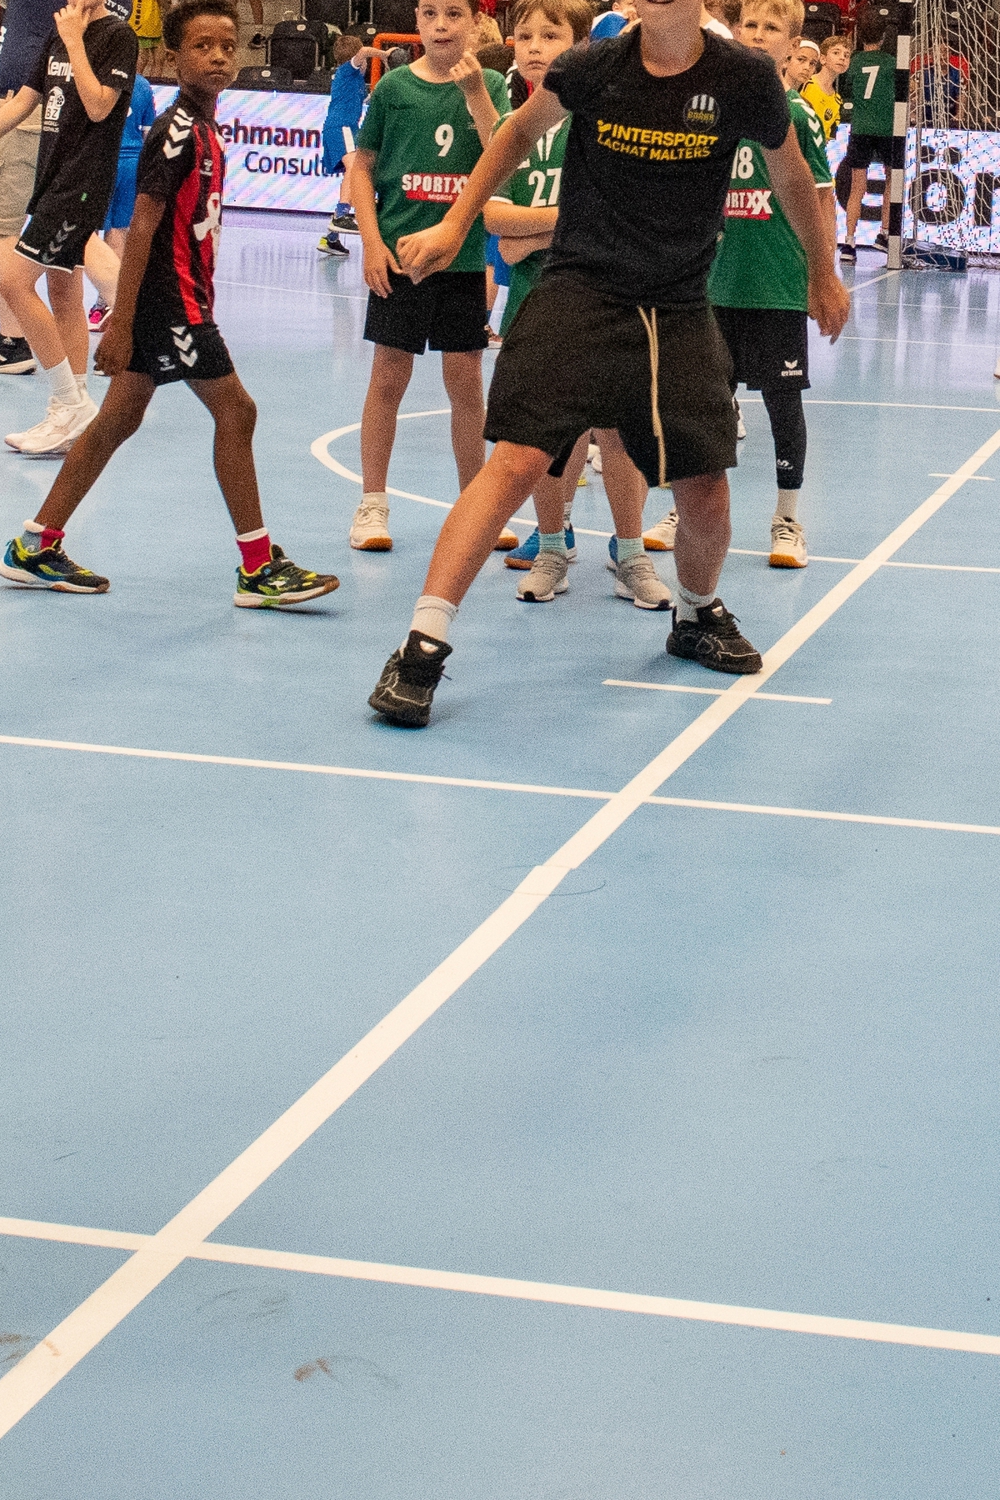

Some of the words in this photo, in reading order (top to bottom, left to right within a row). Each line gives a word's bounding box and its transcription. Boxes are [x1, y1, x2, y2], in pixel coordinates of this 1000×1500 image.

[48, 56, 74, 82] emp
[862, 66, 880, 99] 7
[434, 124, 455, 157] 9
[597, 133, 648, 158] LACHAT
[649, 147, 712, 161] MALTERS
[612, 124, 718, 148] INTERSPORT
[528, 167, 562, 208] 27
